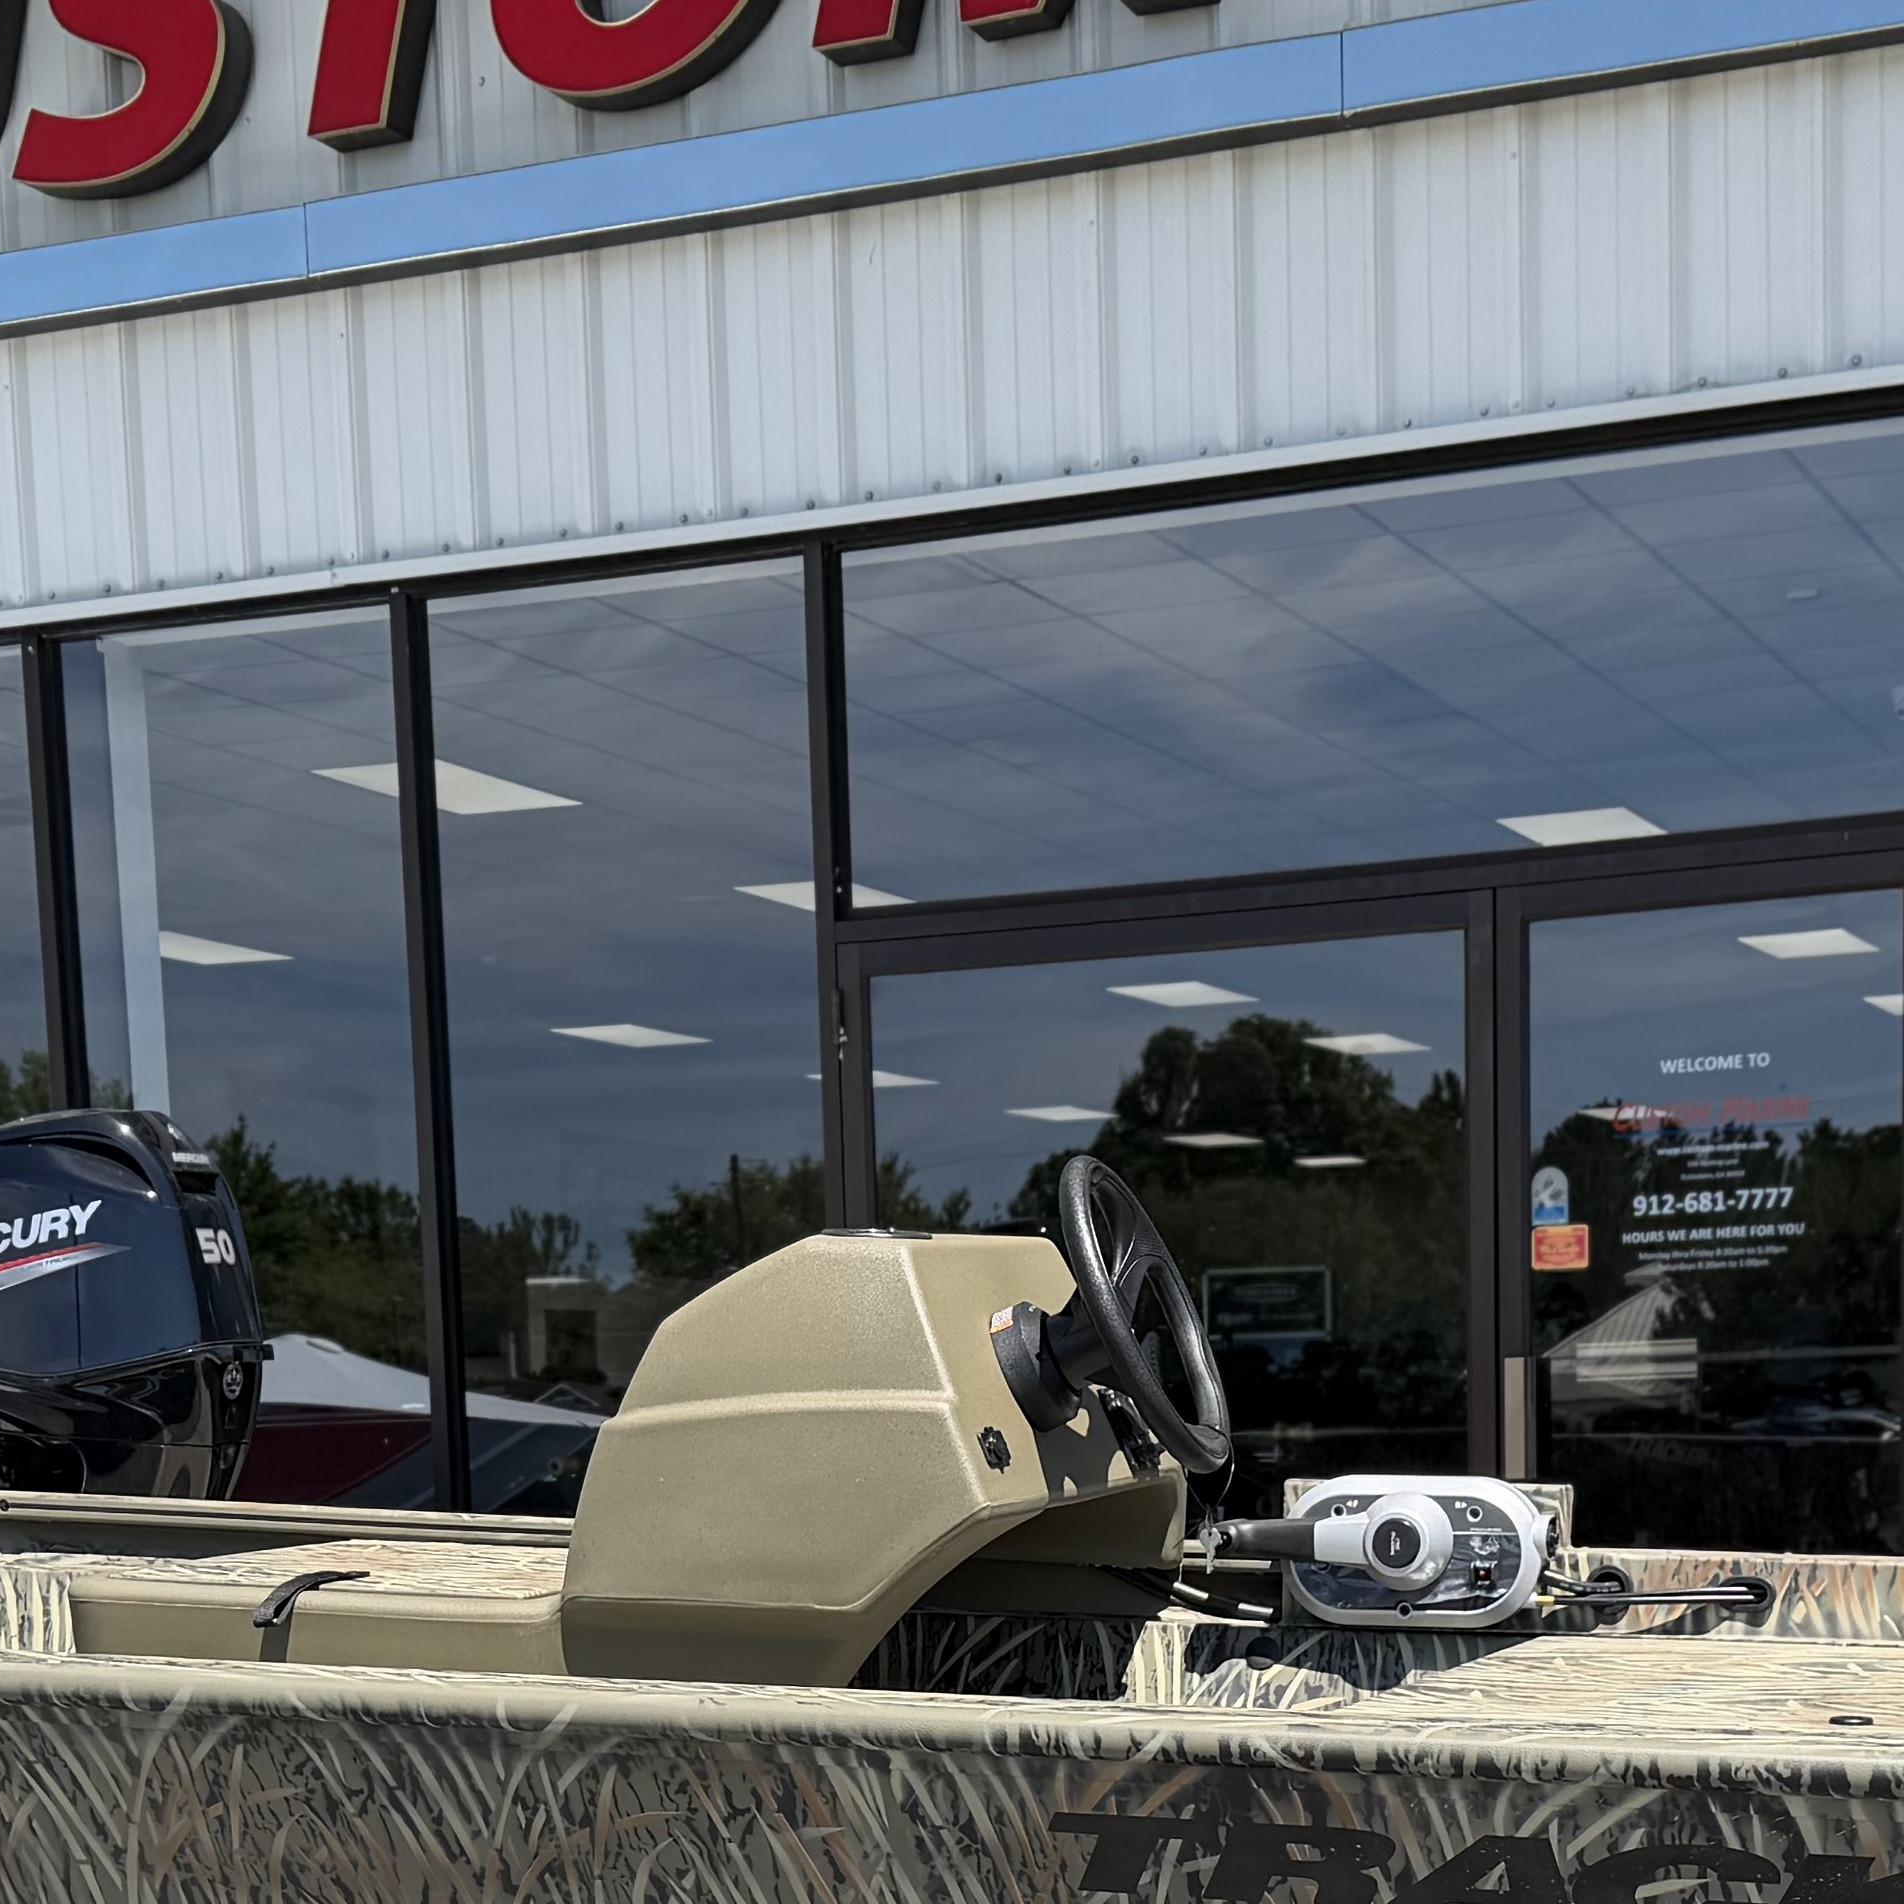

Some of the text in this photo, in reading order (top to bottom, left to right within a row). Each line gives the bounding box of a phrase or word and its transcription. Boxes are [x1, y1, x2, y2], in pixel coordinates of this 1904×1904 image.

[1660, 1052, 1771, 1075] WELCOME TO
[1632, 1186, 1794, 1217] 912-681-7777
[196, 1227, 236, 1266] 50
[1622, 1222, 1805, 1245] HOURS WE ARE HERE FOR YOU
